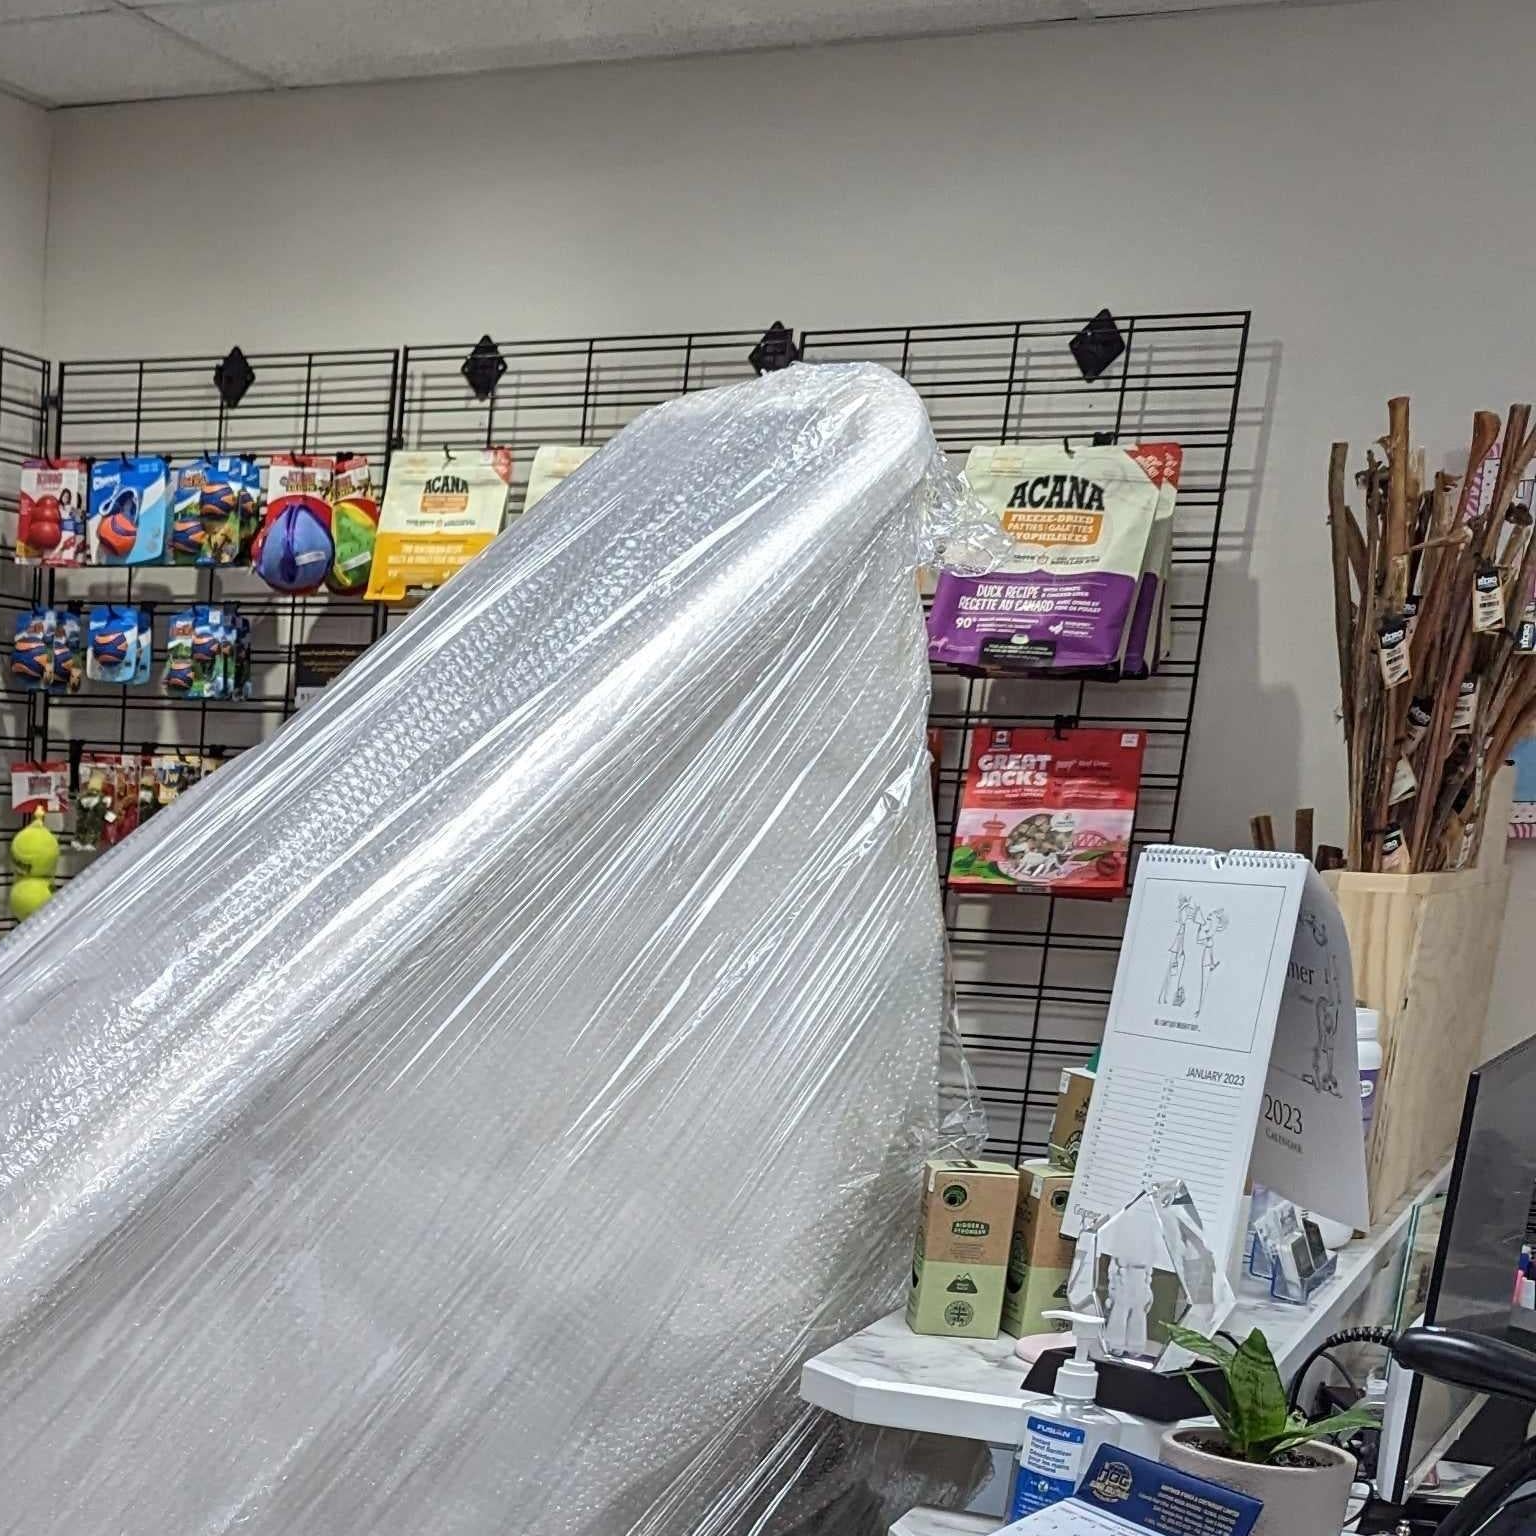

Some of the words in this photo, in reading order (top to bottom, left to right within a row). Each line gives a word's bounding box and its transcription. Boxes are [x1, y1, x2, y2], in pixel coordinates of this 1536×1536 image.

[424, 475, 469, 493] ACANA
[1006, 475, 1104, 511] ACANA
[1008, 522, 1043, 531] PATTIES
[1011, 514, 1094, 524] FREEZE-DRIED
[976, 585, 1004, 597] DUCK
[1005, 586, 1040, 599] RECIPE
[958, 596, 997, 610] RECETTE
[999, 599, 1011, 610] AU
[1014, 599, 1054, 612] CANARD
[978, 754, 1052, 771] GREAT
[976, 770, 1048, 788] JACK'S
[1186, 1067, 1222, 1081] JANUARY
[1224, 1073, 1245, 1086] 2023
[1264, 1094, 1303, 1135] 2023
[1037, 1423, 1071, 1438] FUSION
